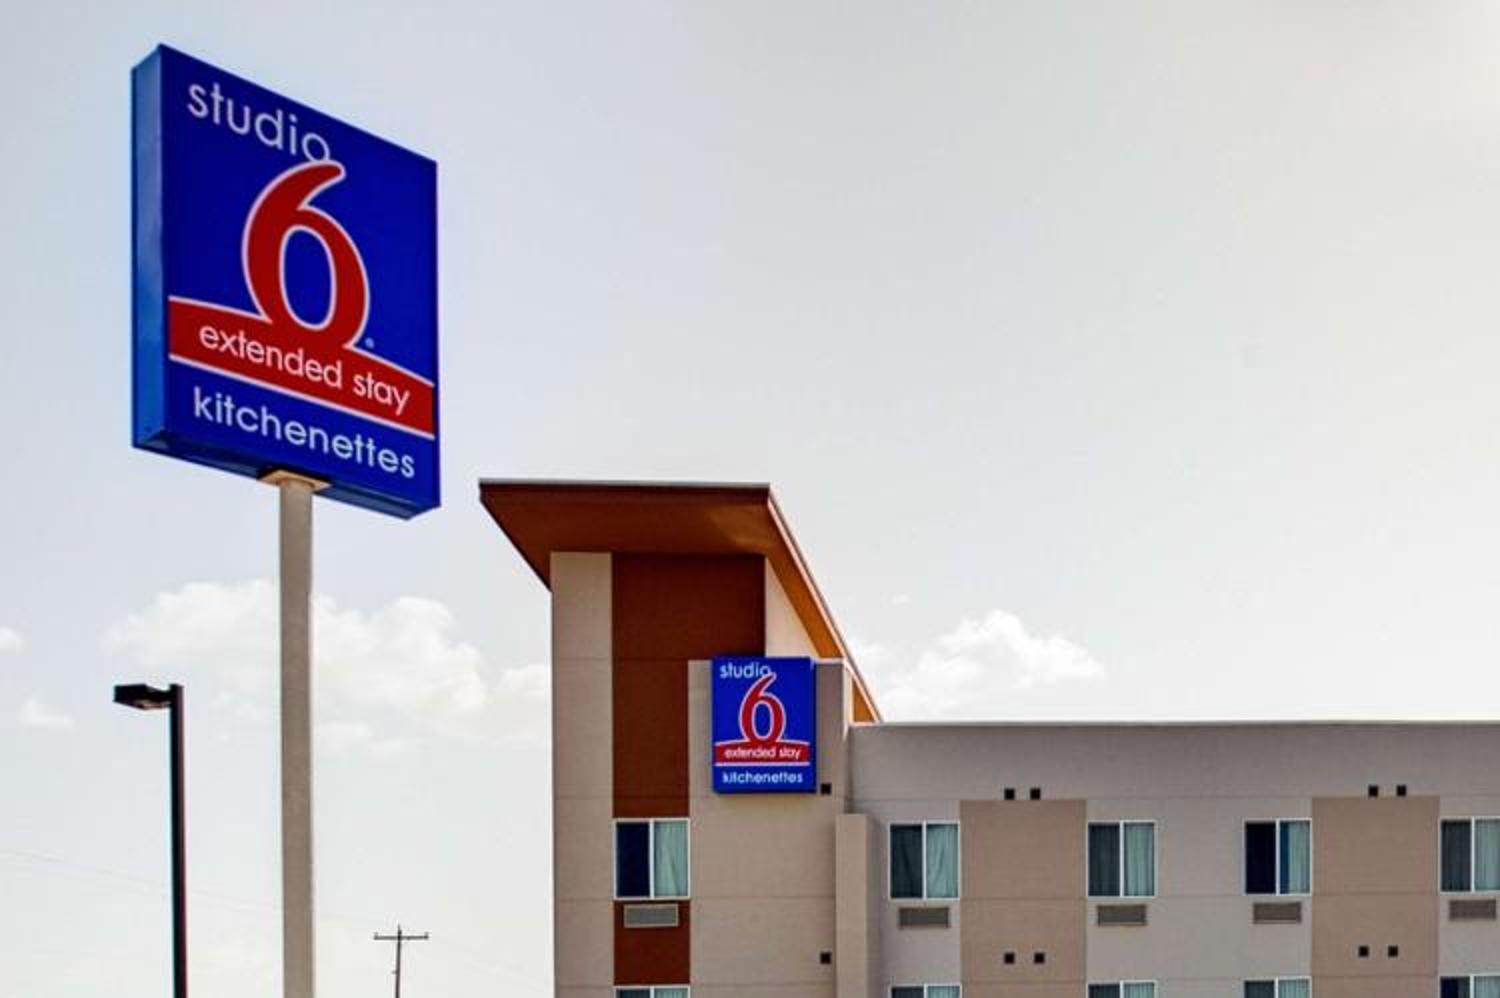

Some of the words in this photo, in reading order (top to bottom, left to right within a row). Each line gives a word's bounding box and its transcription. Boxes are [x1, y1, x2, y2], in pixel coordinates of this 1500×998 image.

[186, 82, 331, 162] studio
[241, 159, 371, 348] 6
[199, 323, 343, 388] extended
[353, 369, 410, 416] stay
[193, 385, 416, 479] kitchenettes
[719, 662, 771, 679] studio
[738, 671, 787, 742] 6
[722, 771, 804, 784] kitchenettes
[724, 746, 777, 759] extended
[779, 747, 801, 760] stay
